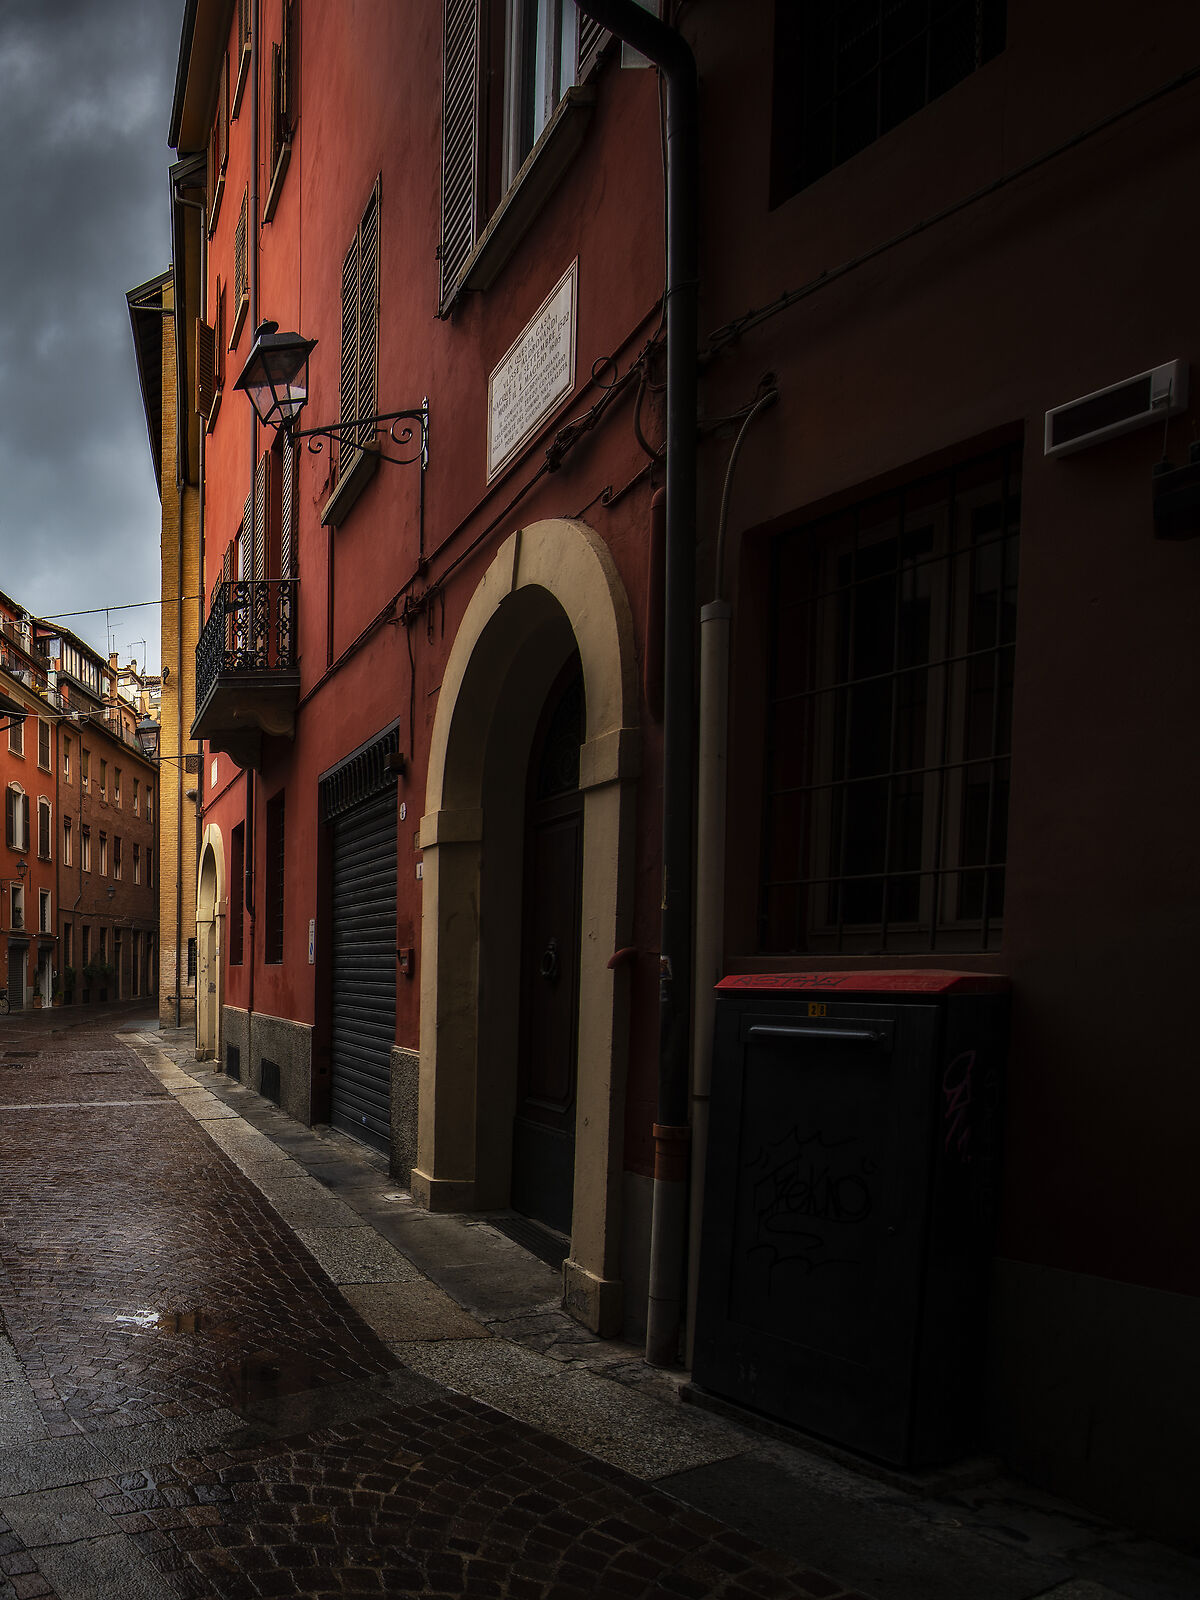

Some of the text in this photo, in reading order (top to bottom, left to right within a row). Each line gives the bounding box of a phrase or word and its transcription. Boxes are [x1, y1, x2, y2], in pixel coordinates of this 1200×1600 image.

[521, 313, 558, 366] ALDROVANDI
[535, 313, 551, 336] CASA
[523, 328, 556, 375] SETTEMBRE
[557, 311, 569, 331] 1522
[524, 351, 547, 385] MAGGIO
[538, 353, 565, 389] CENTENARIO
[810, 1005, 825, 1016] 28
